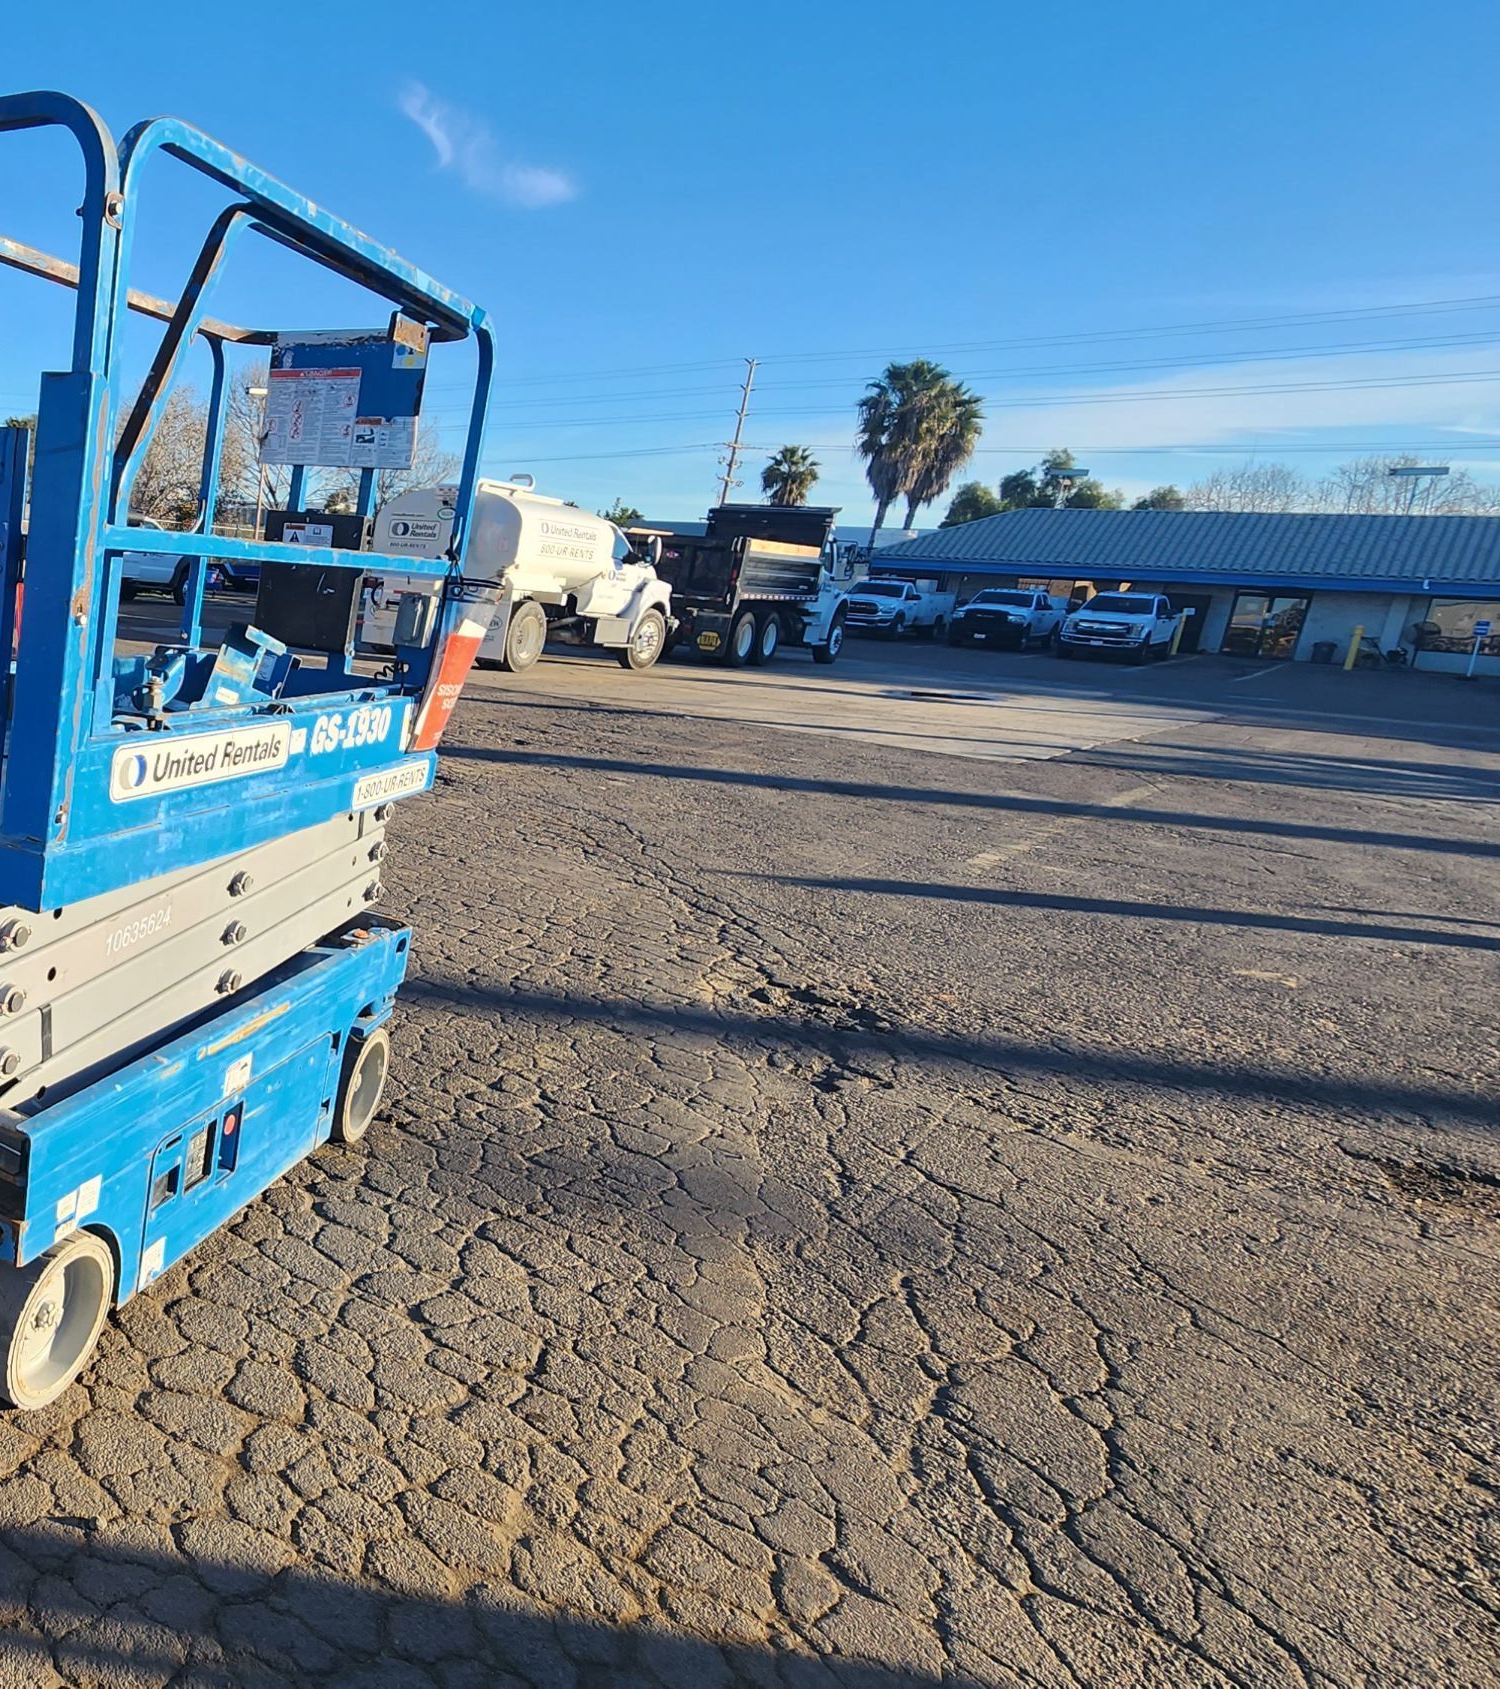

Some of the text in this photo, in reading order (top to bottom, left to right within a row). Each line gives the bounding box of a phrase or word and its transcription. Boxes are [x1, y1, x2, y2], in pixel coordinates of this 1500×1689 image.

[410, 529, 437, 538] Rentals
[411, 522, 437, 531] United
[550, 524, 598, 541] United Rentals
[310, 706, 392, 755] GS-1930
[153, 733, 282, 782] United Rentals
[356, 767, 428, 801] 1-800-UR-RENTS
[106, 904, 172, 956] 10635624
